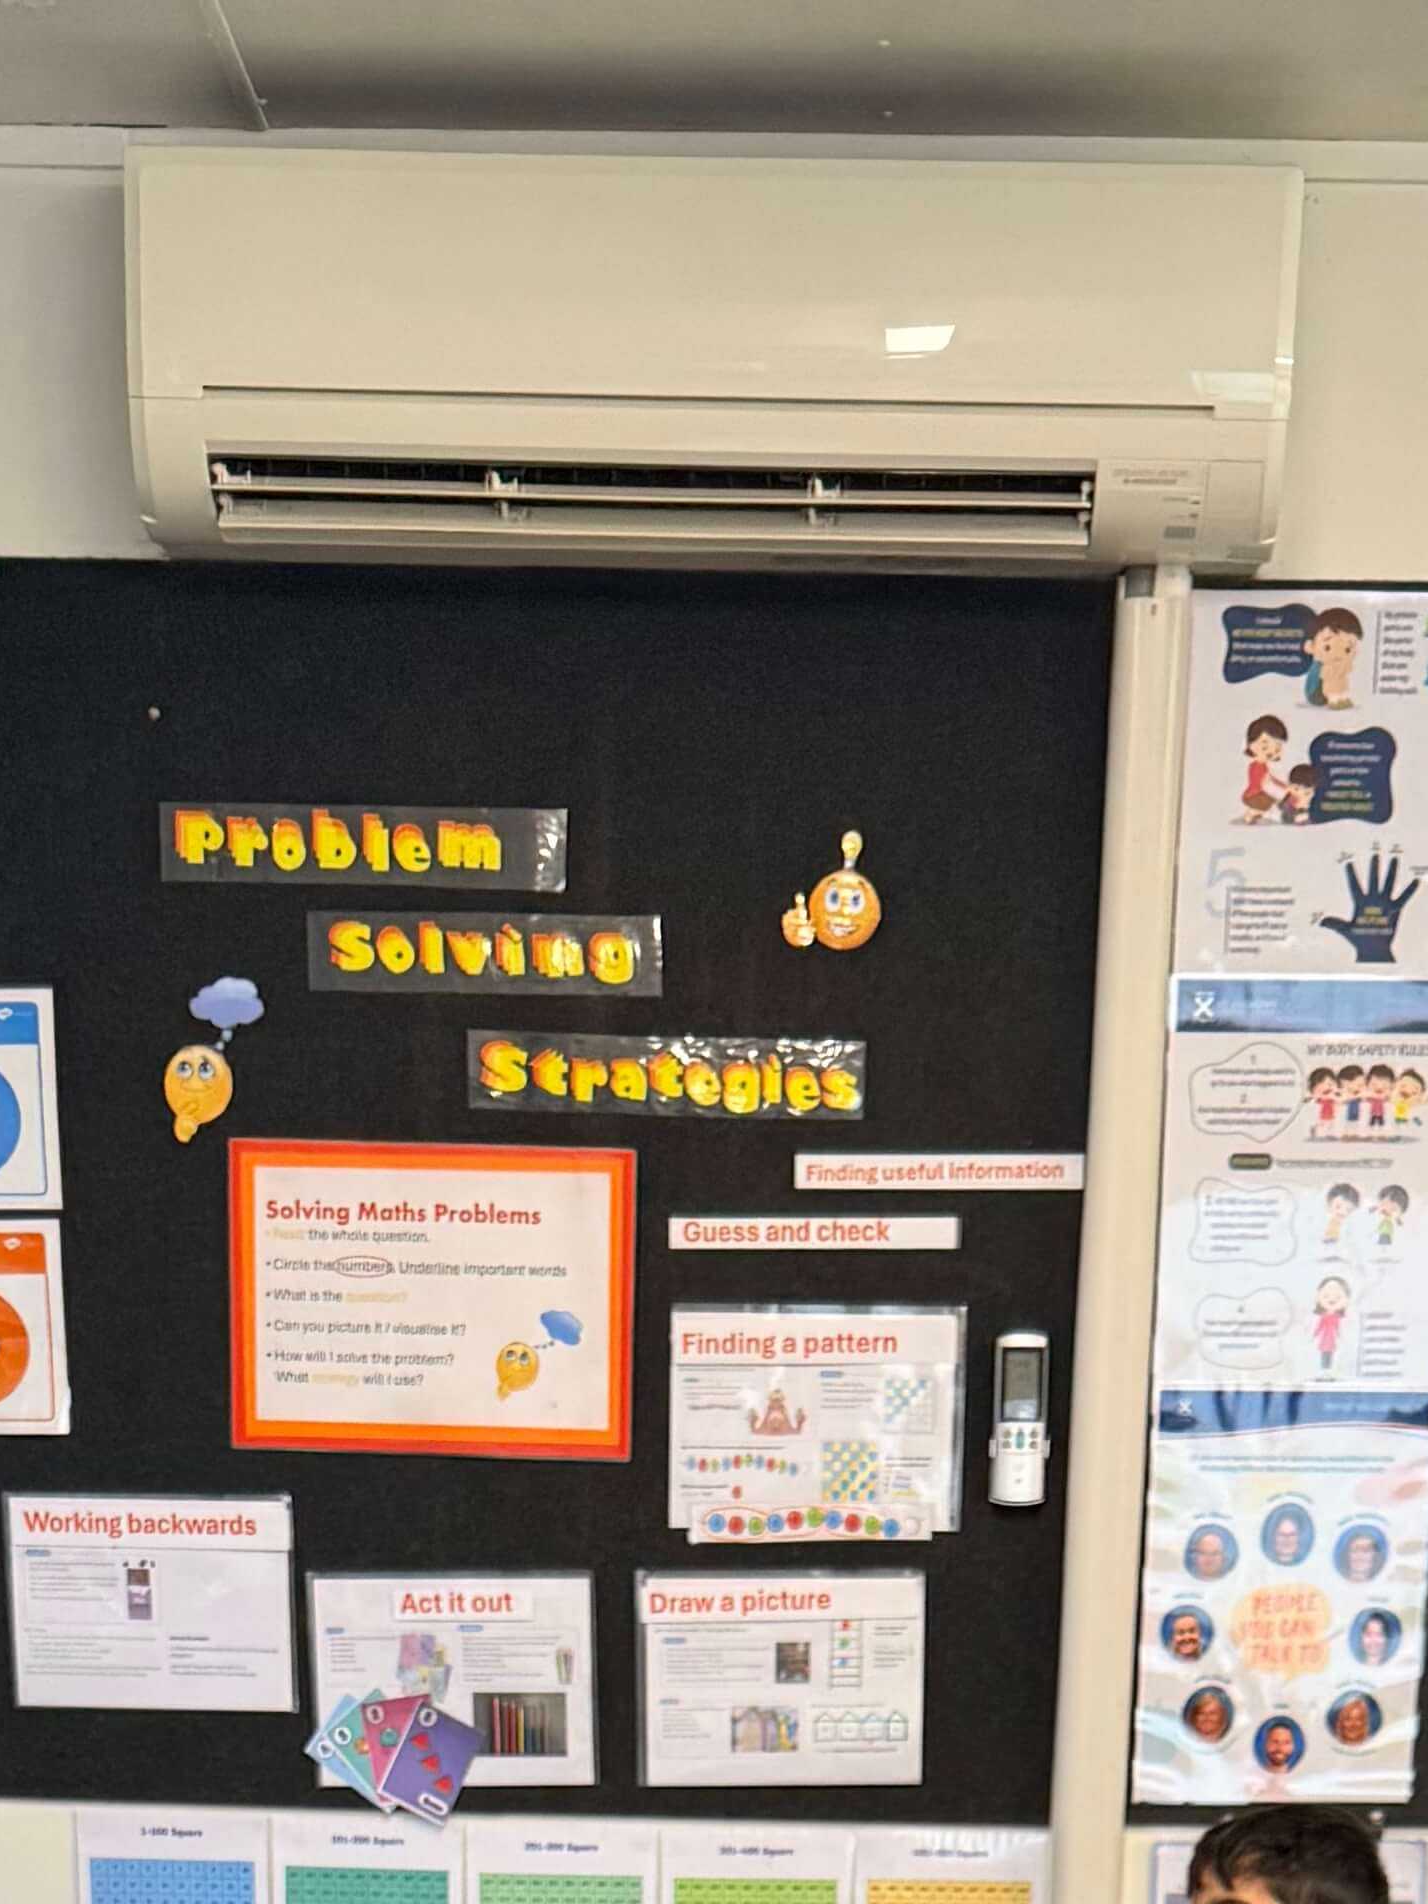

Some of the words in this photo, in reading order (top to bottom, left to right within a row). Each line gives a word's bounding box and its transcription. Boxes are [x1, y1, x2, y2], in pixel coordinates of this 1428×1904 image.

[175, 810, 502, 874] Problem
[329, 921, 635, 985] Solving
[479, 1039, 859, 1115] Strategies
[805, 1164, 878, 1184] Finding
[882, 1162, 944, 1181] useful
[949, 1161, 1064, 1179] information
[266, 1200, 351, 1226] Solving
[357, 1201, 427, 1223] Maths
[433, 1203, 542, 1226] Problems
[683, 1221, 759, 1242] Guess
[766, 1221, 810, 1242] and
[816, 1219, 890, 1241] check
[681, 1332, 775, 1359] Finding
[781, 1339, 795, 1353] a
[803, 1335, 898, 1359] pattern
[24, 1512, 122, 1539] Working
[127, 1513, 257, 1537] backwards
[400, 1591, 443, 1615] Act
[448, 1591, 467, 1614] it
[470, 1592, 513, 1614] out
[649, 1592, 714, 1616] Draw
[720, 1596, 736, 1613] a
[741, 1589, 831, 1618] picture
